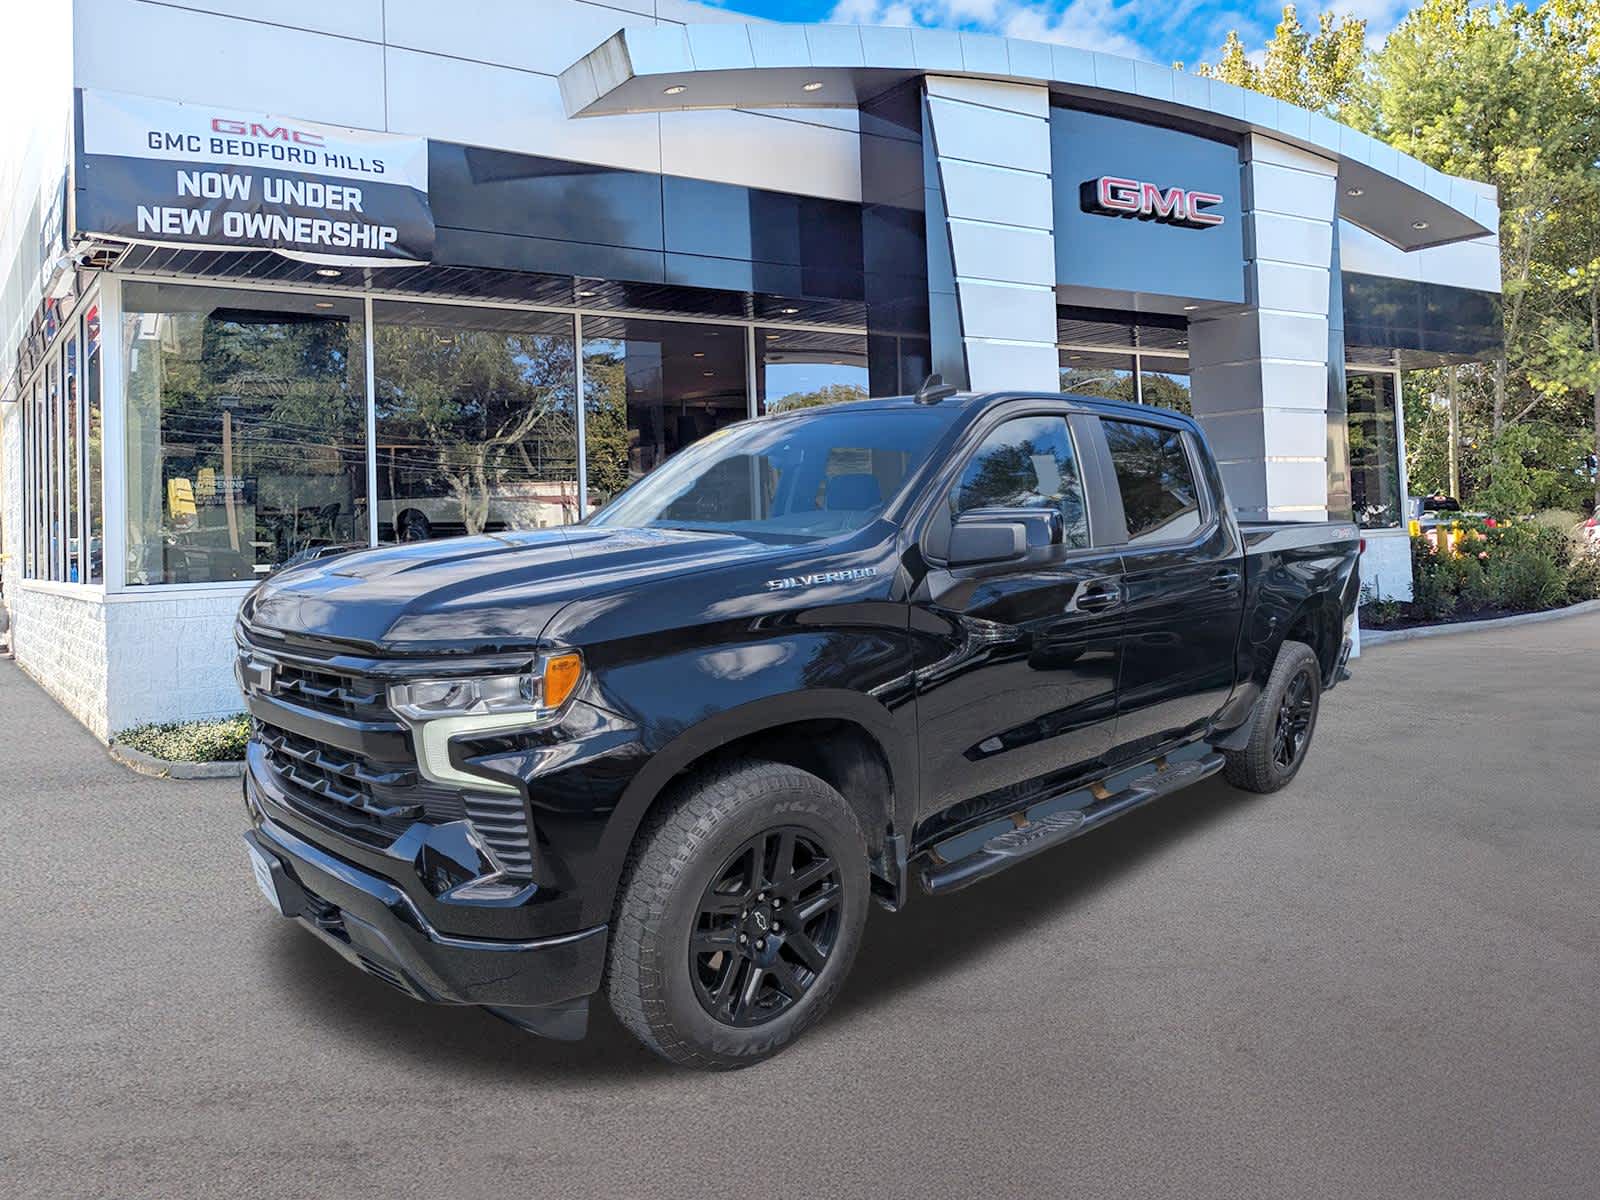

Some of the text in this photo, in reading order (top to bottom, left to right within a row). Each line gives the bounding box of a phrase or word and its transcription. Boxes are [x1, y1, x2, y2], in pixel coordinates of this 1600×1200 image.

[148, 131, 385, 174] GMC BEDFORD HILLS
[211, 119, 325, 148] GMC
[177, 170, 363, 213] NOW UNDER
[1098, 175, 1224, 225] GMC
[136, 205, 398, 249] NEW OWNERSHIP
[768, 567, 877, 591] SILVERADO
